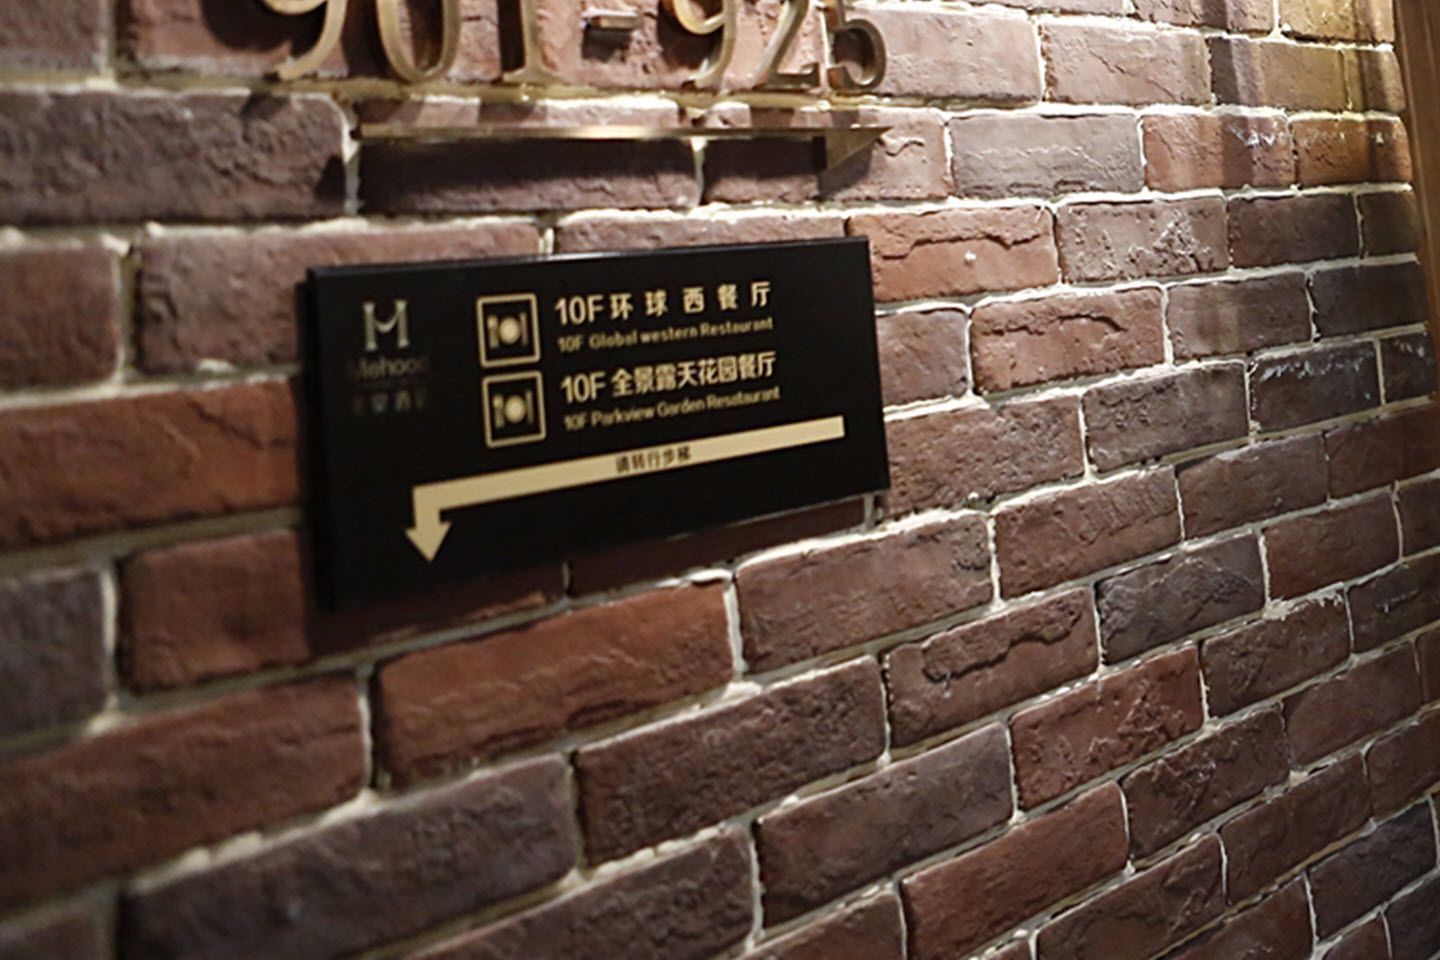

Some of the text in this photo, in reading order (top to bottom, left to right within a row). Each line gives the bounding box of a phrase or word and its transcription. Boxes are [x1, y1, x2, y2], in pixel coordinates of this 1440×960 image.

[588, 327, 639, 350] Global
[640, 323, 699, 344] western
[699, 317, 774, 338] Restaurant
[591, 402, 656, 428] Parkview
